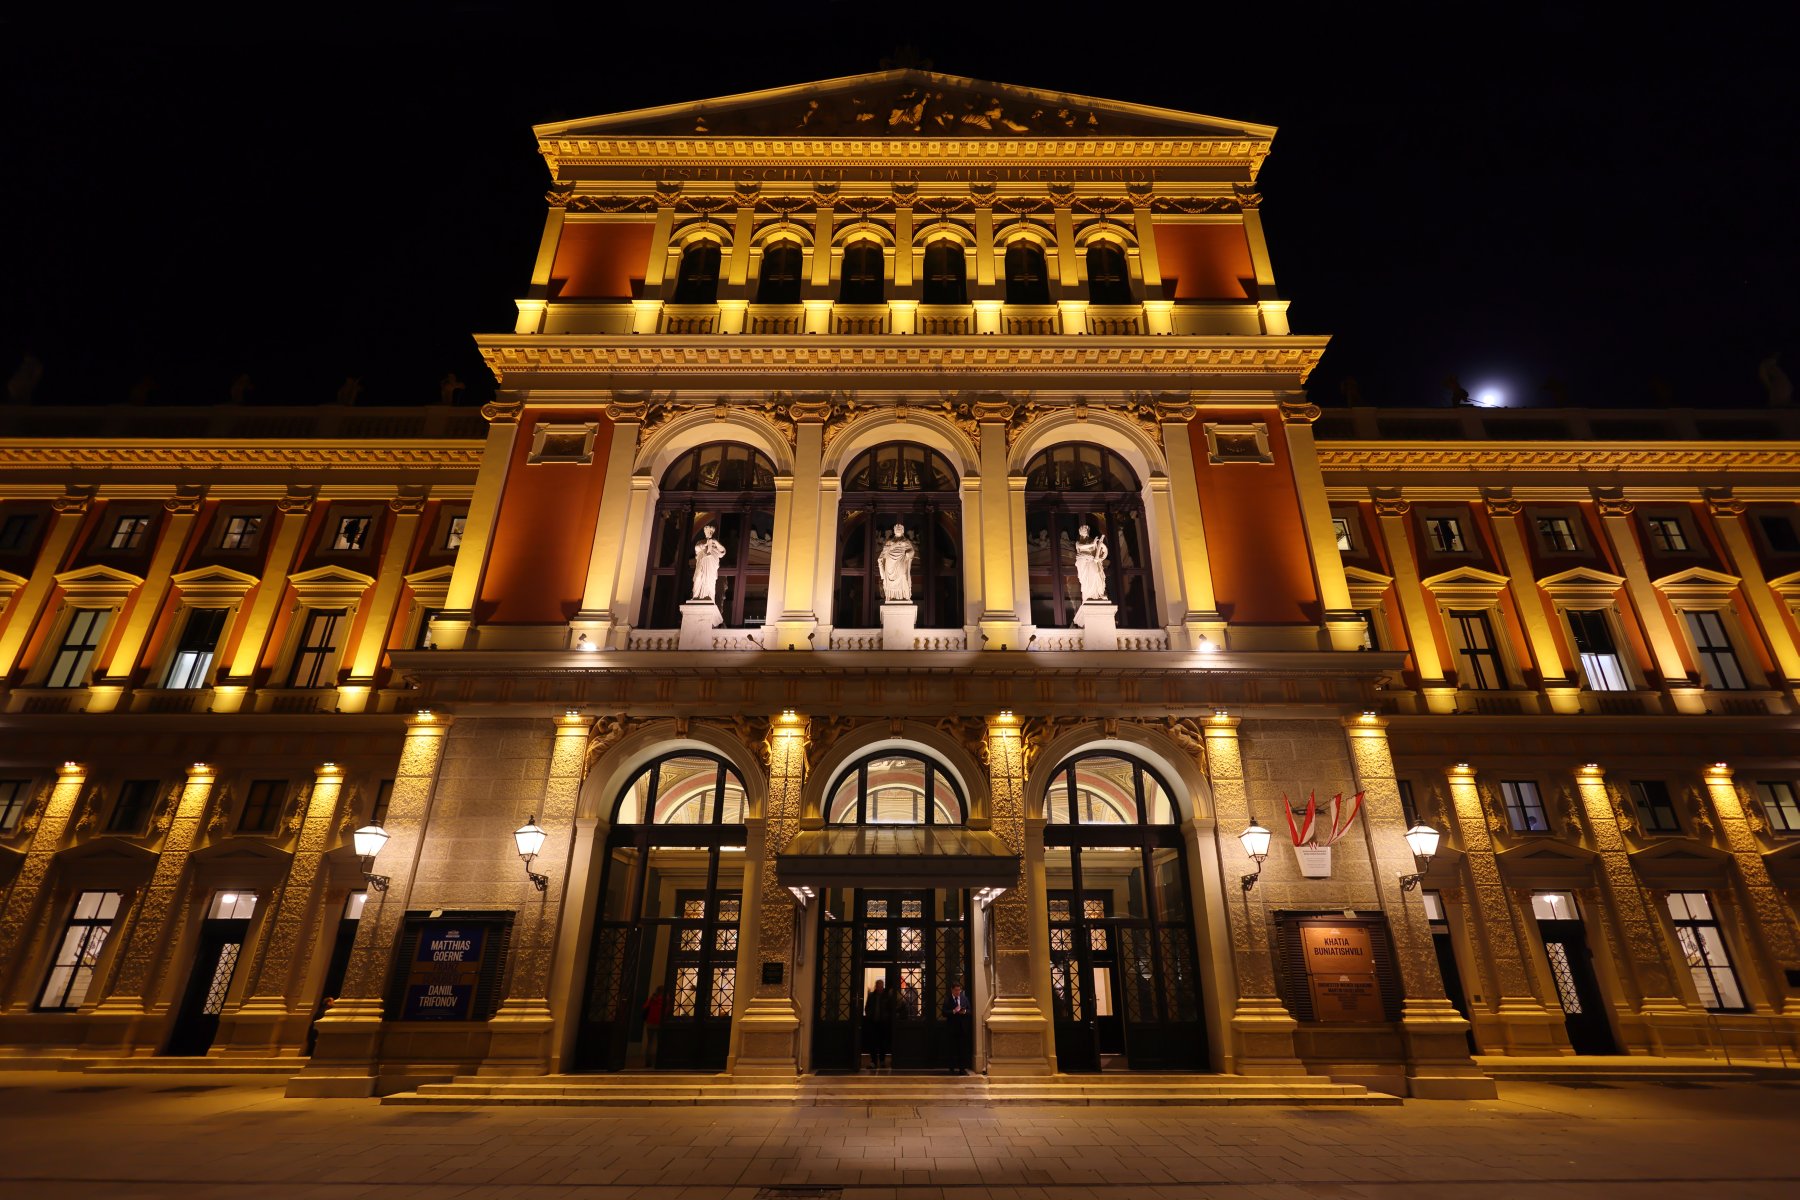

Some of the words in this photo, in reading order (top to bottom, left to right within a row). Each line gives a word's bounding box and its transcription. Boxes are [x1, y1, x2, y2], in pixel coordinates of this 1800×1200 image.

[641, 168, 849, 181] GESELLSCHAFT
[869, 168, 920, 181] DER
[945, 168, 1164, 181] MUSIKFREUNDE
[430, 940, 471, 951] MATTHIAS
[1324, 938, 1350, 946] KHATIA
[433, 951, 464, 962] GOERNE
[1314, 947, 1363, 956] BUNIATISHVILI
[428, 985, 454, 996] DANIIL
[418, 996, 458, 1008] TRIFONOV
